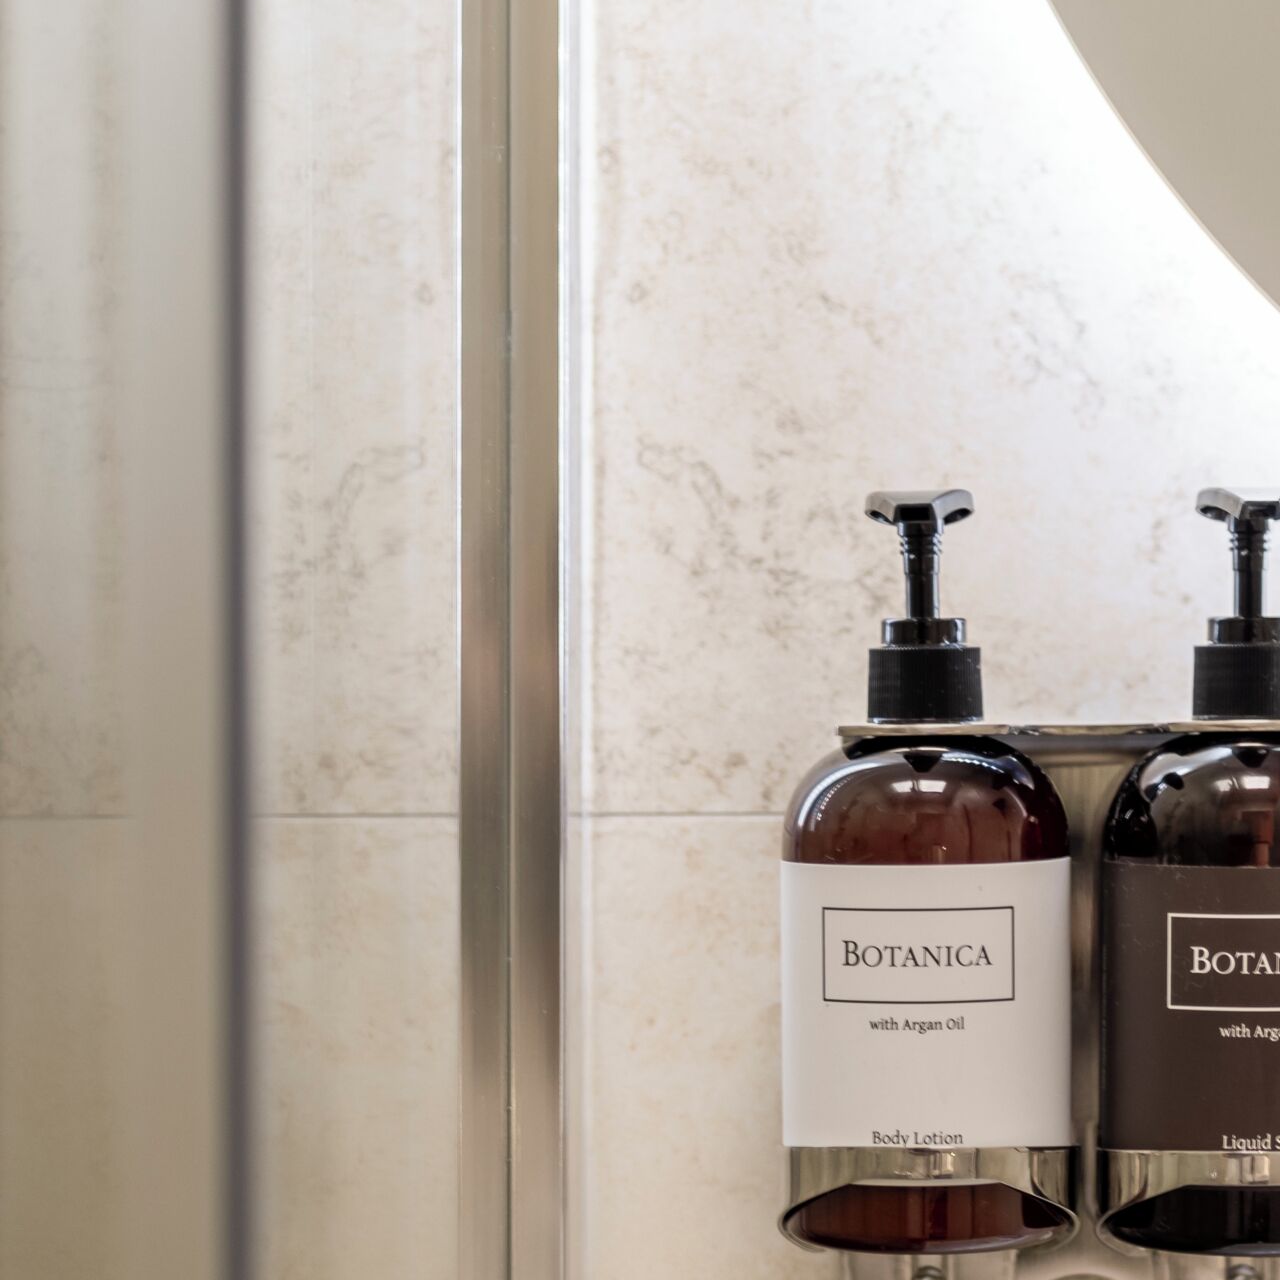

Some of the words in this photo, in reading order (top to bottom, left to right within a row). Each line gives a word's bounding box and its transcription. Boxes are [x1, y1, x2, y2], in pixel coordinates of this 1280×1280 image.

[842, 940, 992, 967] BOTANICA
[869, 1017, 899, 1031] with
[903, 1019, 943, 1035] Argan
[946, 1016, 965, 1031] Oil
[1219, 1023, 1251, 1038] with
[872, 1129, 909, 1147] Body
[914, 1131, 963, 1145] Lotion
[1221, 1133, 1272, 1151] Liquid
